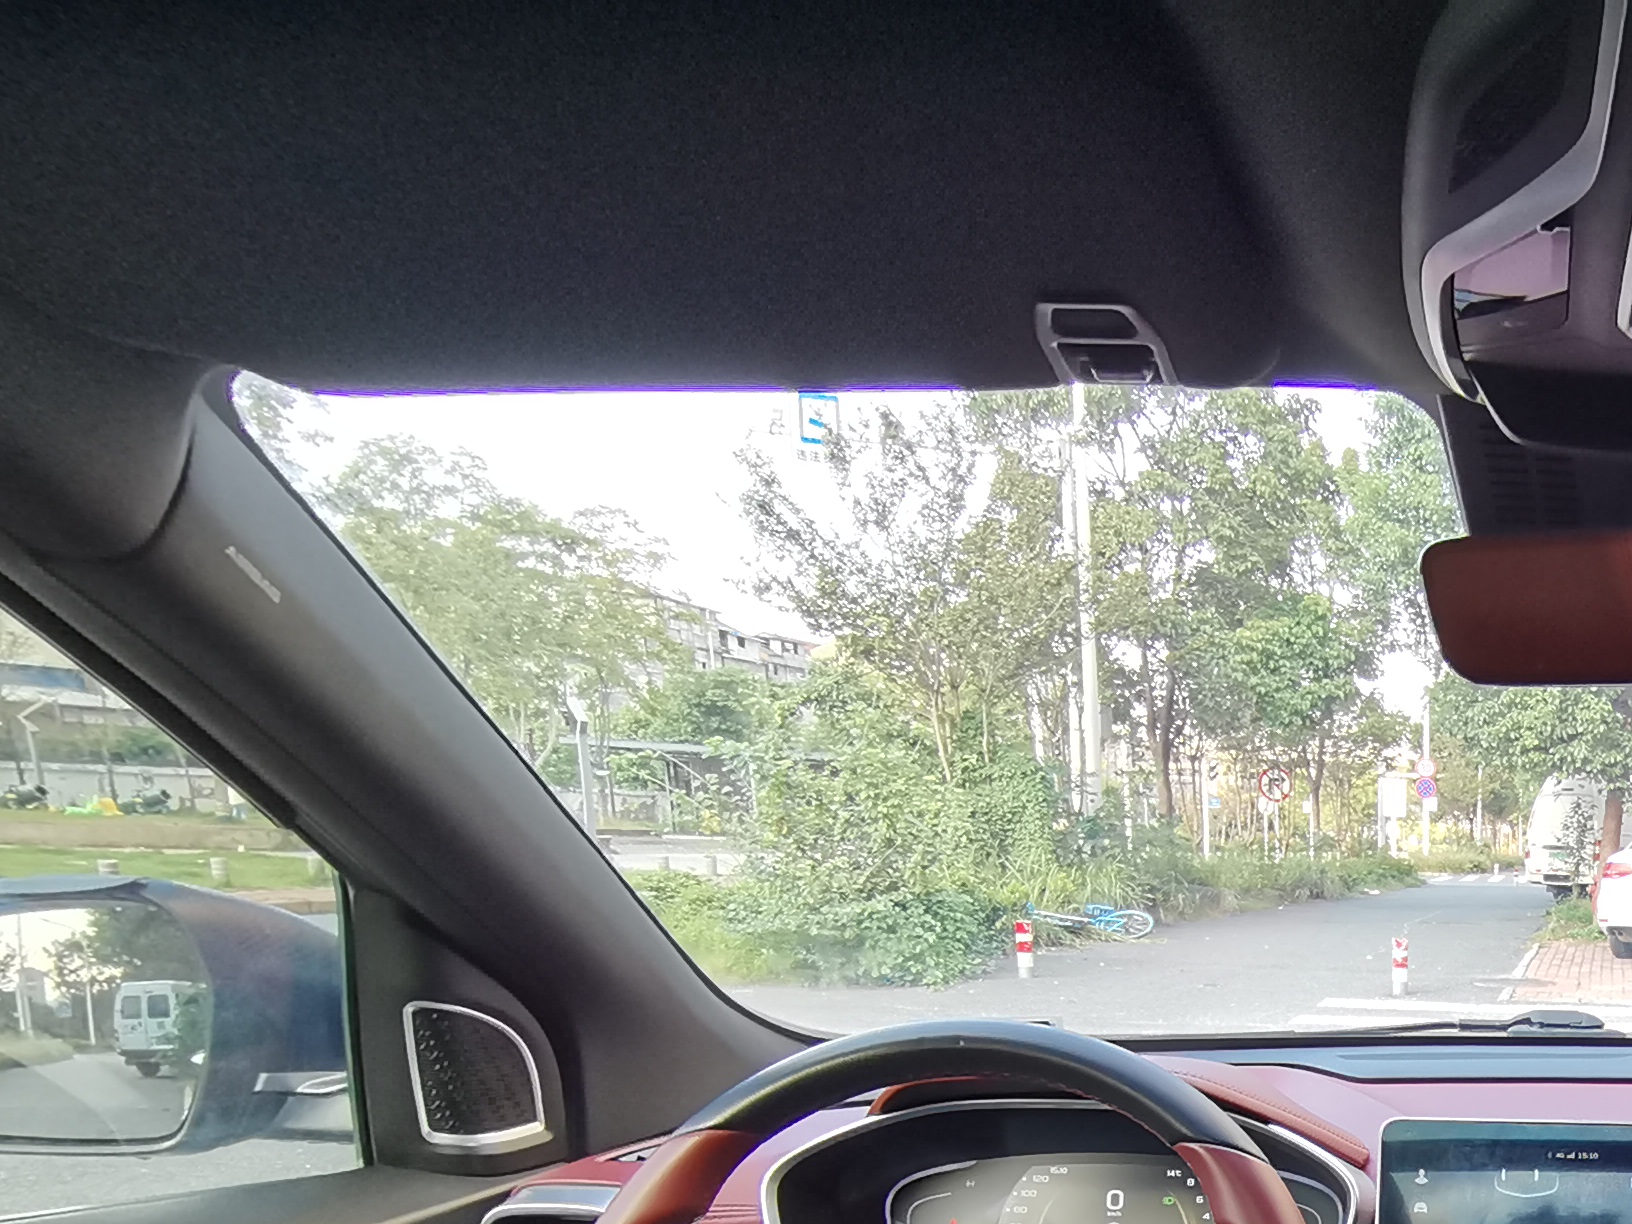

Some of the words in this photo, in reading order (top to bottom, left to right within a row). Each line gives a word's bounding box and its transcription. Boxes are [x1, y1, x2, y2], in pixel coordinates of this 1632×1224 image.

[1032, 1174, 1049, 1183] 120
[1020, 1189, 1038, 1198] 100
[1106, 1189, 1124, 1210] 0
